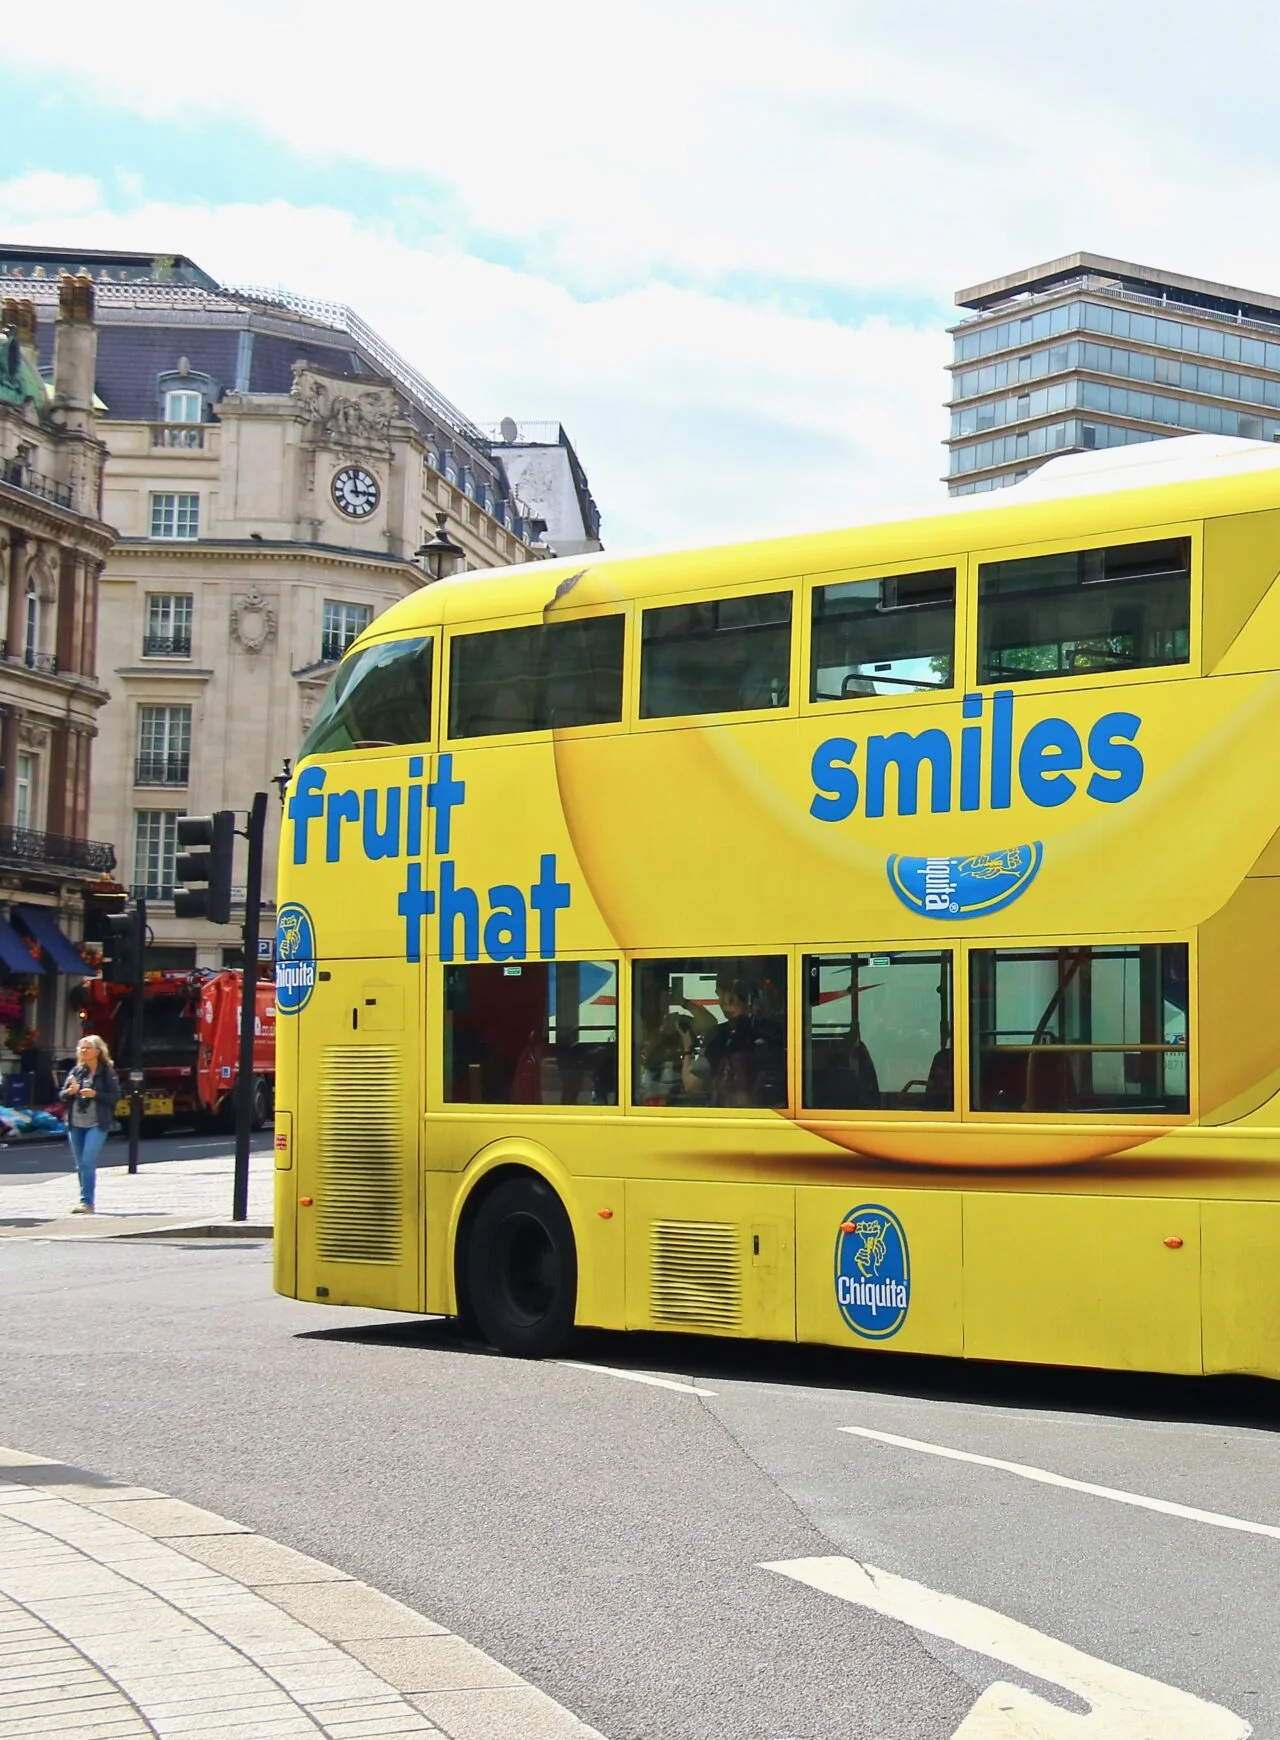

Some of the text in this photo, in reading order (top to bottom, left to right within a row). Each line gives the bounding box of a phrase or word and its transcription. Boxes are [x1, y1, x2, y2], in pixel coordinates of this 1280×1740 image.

[289, 754, 465, 864] fruit
[811, 690, 1144, 822] smiles
[398, 854, 570, 963] that
[837, 1275, 908, 1316] Chiquita
